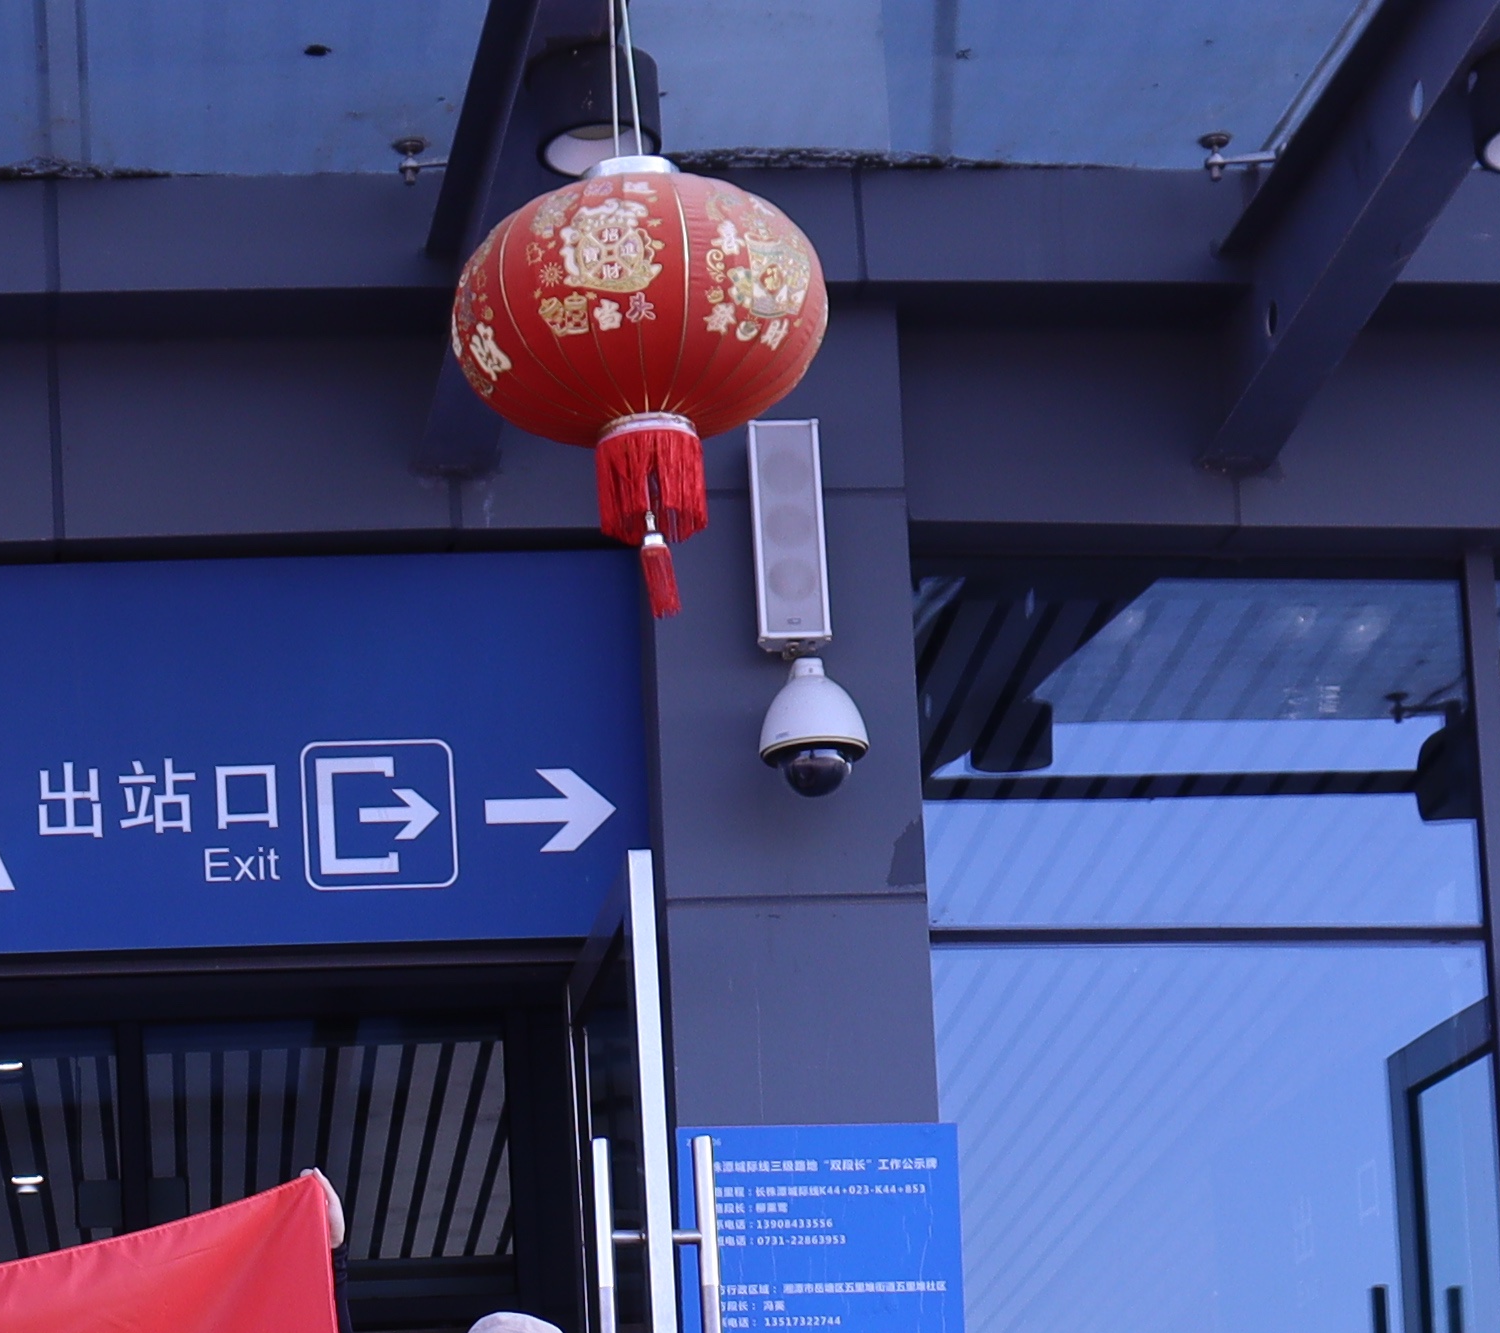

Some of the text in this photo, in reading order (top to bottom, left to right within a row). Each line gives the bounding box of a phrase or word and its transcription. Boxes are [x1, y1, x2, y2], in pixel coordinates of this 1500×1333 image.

[36, 756, 281, 842] 出站口
[204, 846, 281, 884] Exit
